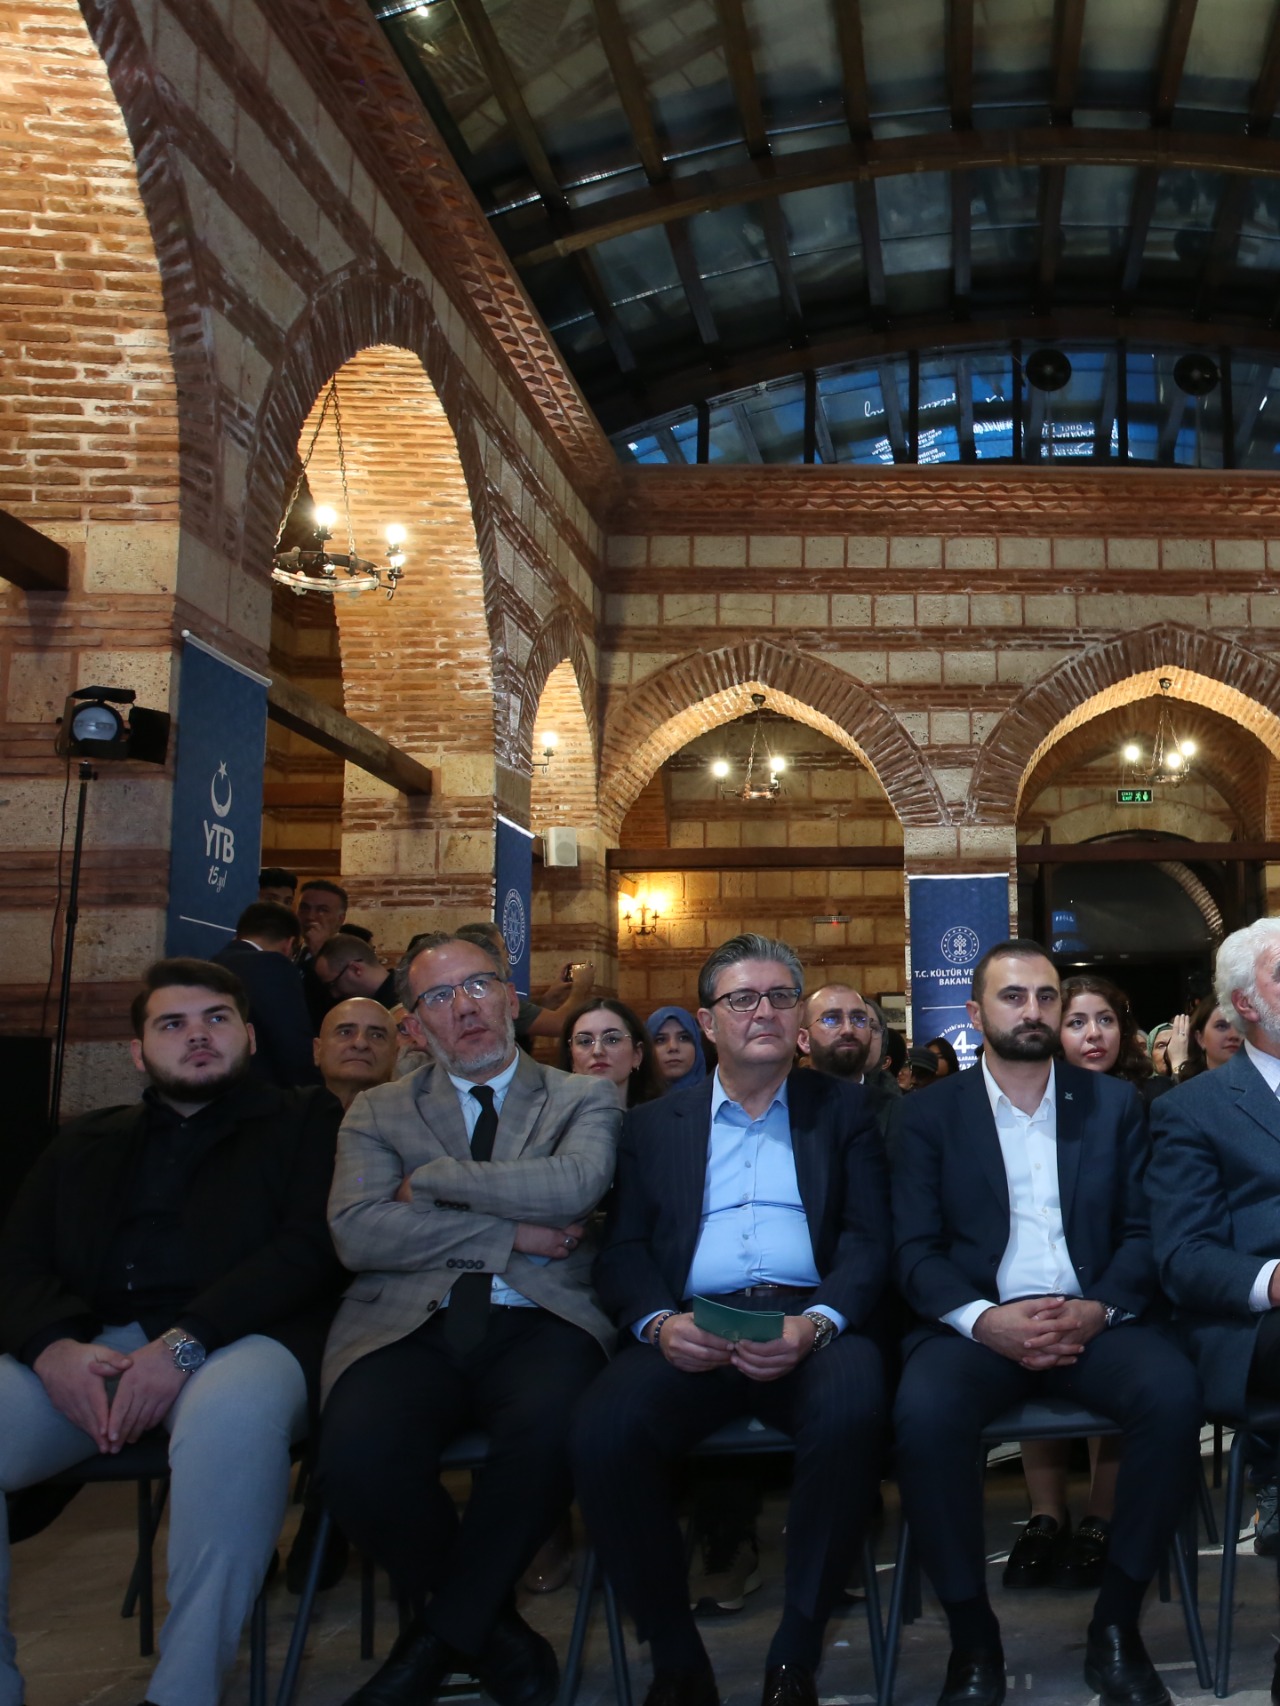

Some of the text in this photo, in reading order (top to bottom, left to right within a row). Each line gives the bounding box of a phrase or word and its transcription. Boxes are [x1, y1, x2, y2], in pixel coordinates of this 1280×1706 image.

[203, 819, 235, 864] YTB
[914, 968, 974, 978] T.C. KÜLTÜR VE
[939, 977, 972, 986] BAKANL
